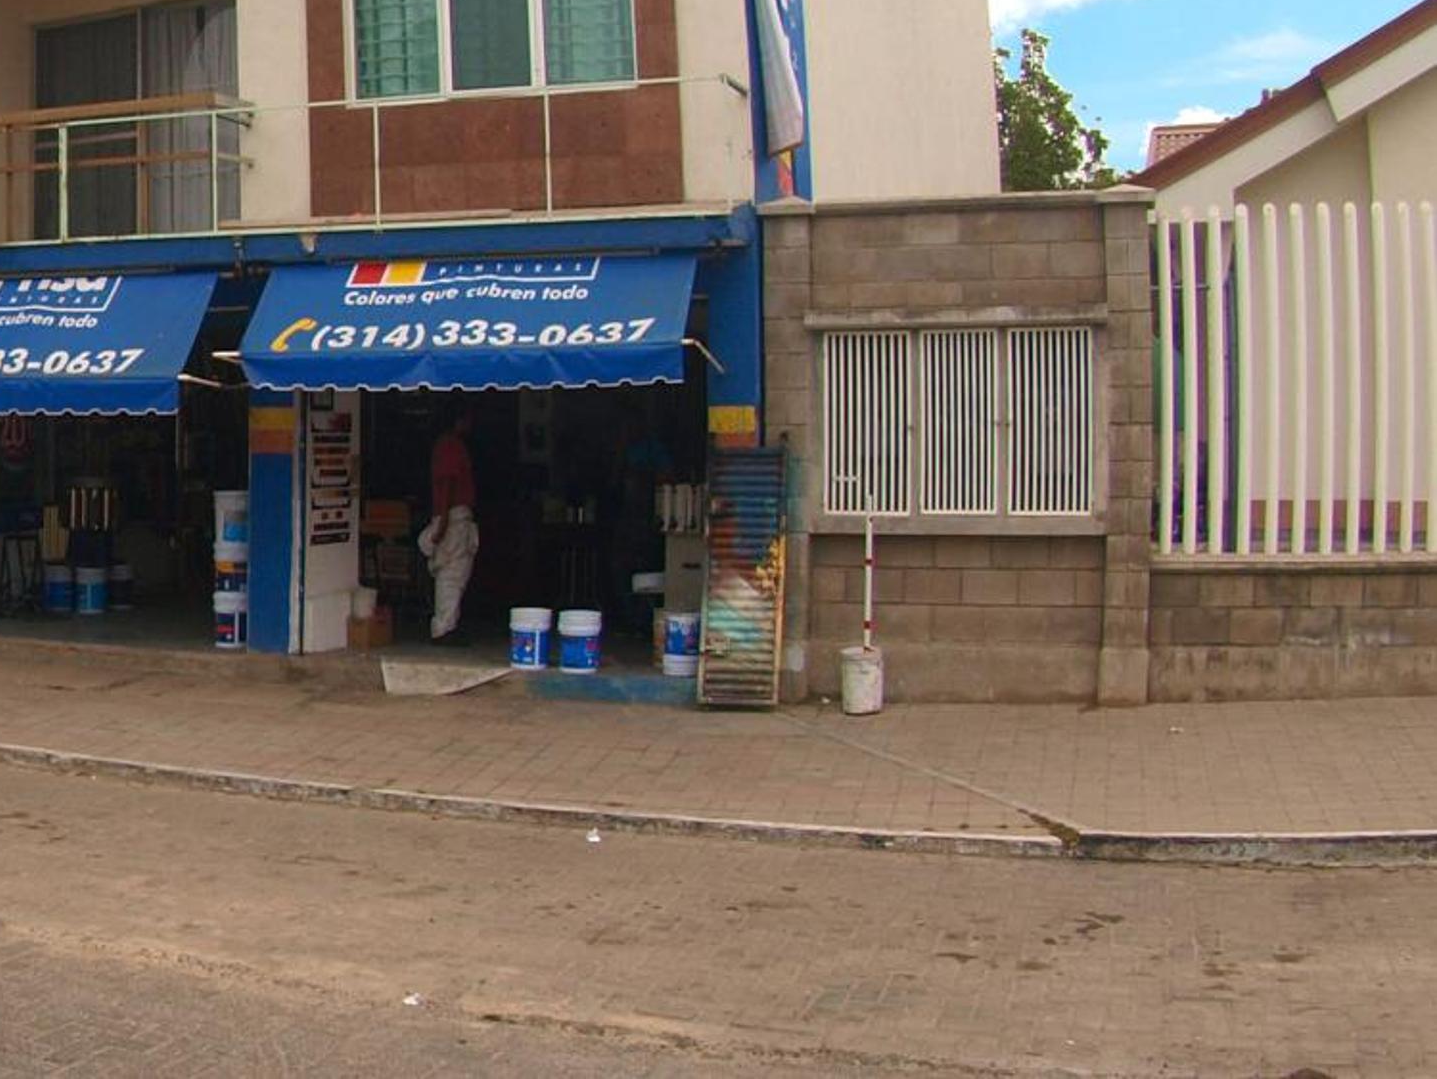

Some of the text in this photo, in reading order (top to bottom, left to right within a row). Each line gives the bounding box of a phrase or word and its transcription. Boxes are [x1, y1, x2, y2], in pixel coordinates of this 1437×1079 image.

[344, 283, 589, 307] Colores que cubren todo
[58, 314, 99, 329] todo
